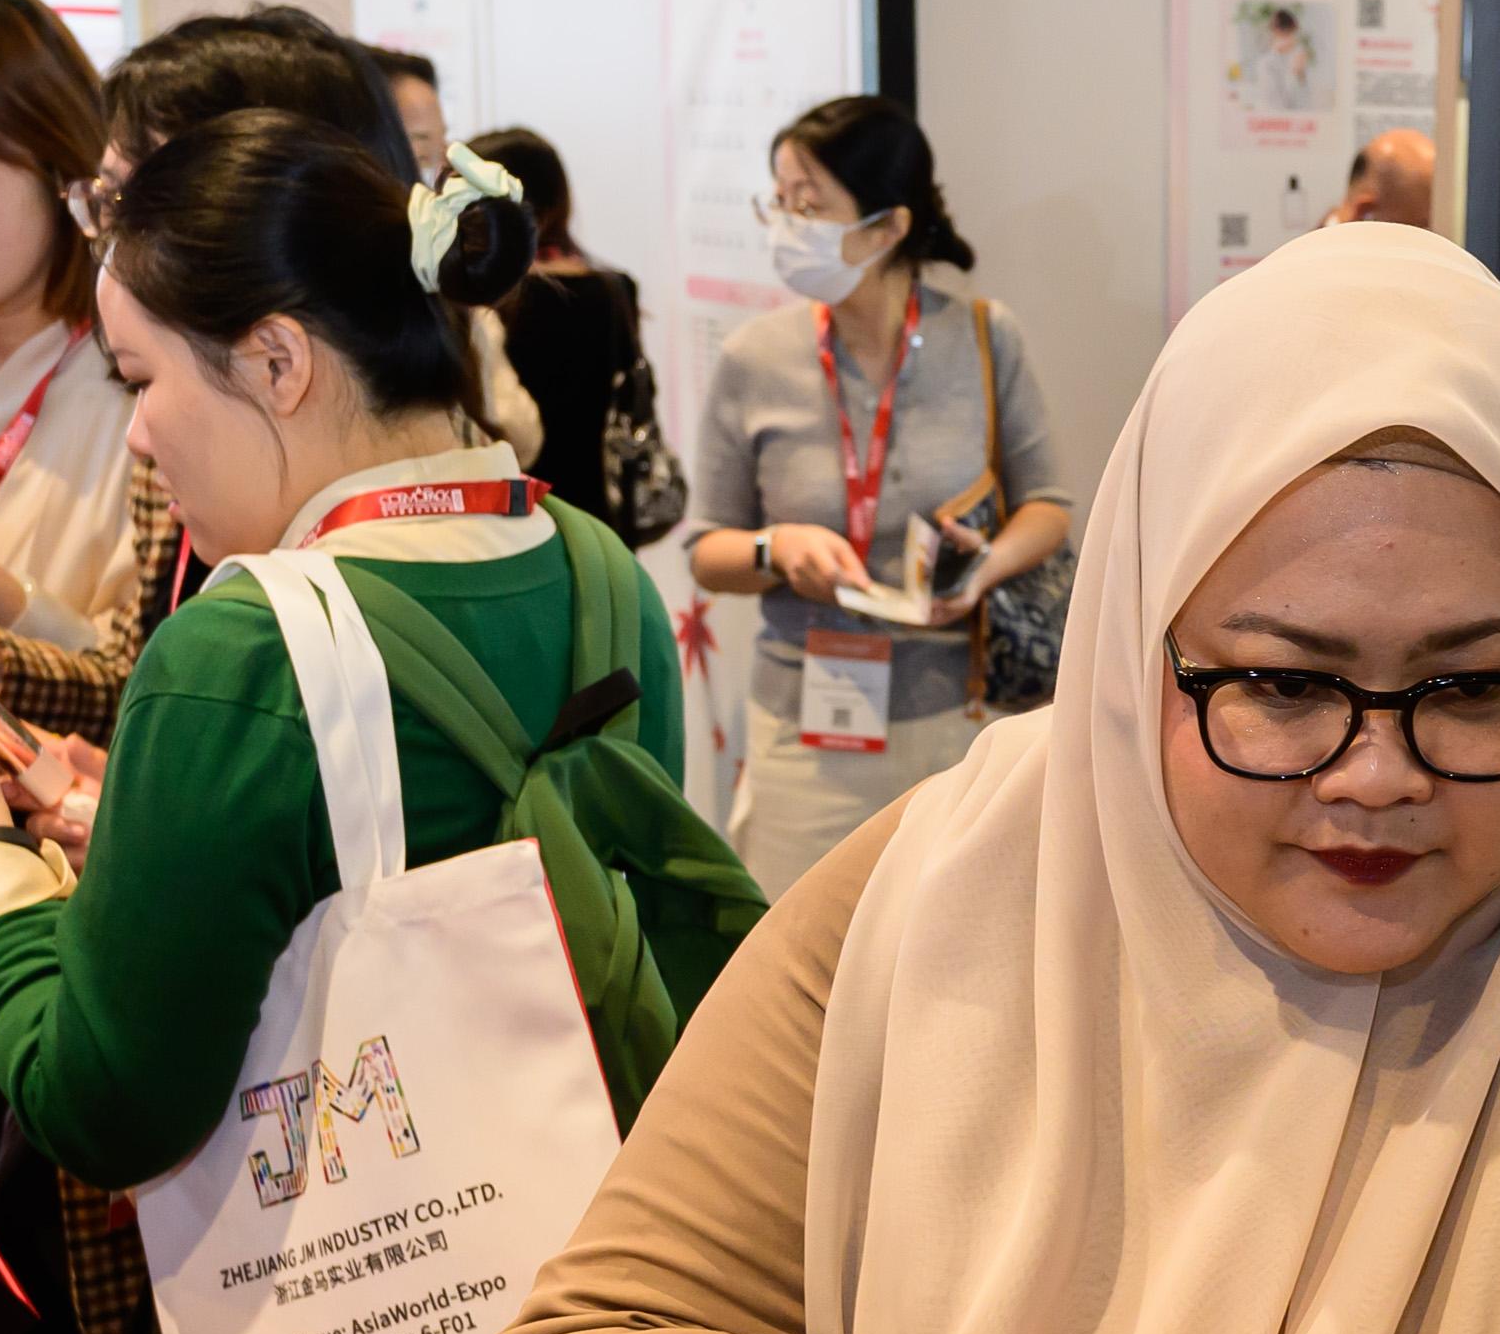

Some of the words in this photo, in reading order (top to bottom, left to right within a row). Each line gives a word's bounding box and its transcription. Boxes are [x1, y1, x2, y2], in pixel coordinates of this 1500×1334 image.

[239, 1034, 420, 1209] JM
[219, 1248, 297, 1290] ZHEJIANG
[299, 1242, 317, 1266] JM
[318, 1208, 409, 1259] INDUSTRY
[414, 1182, 504, 1224] CO.,LTD.
[274, 1229, 449, 1307] 浙江金马实业有限公司
